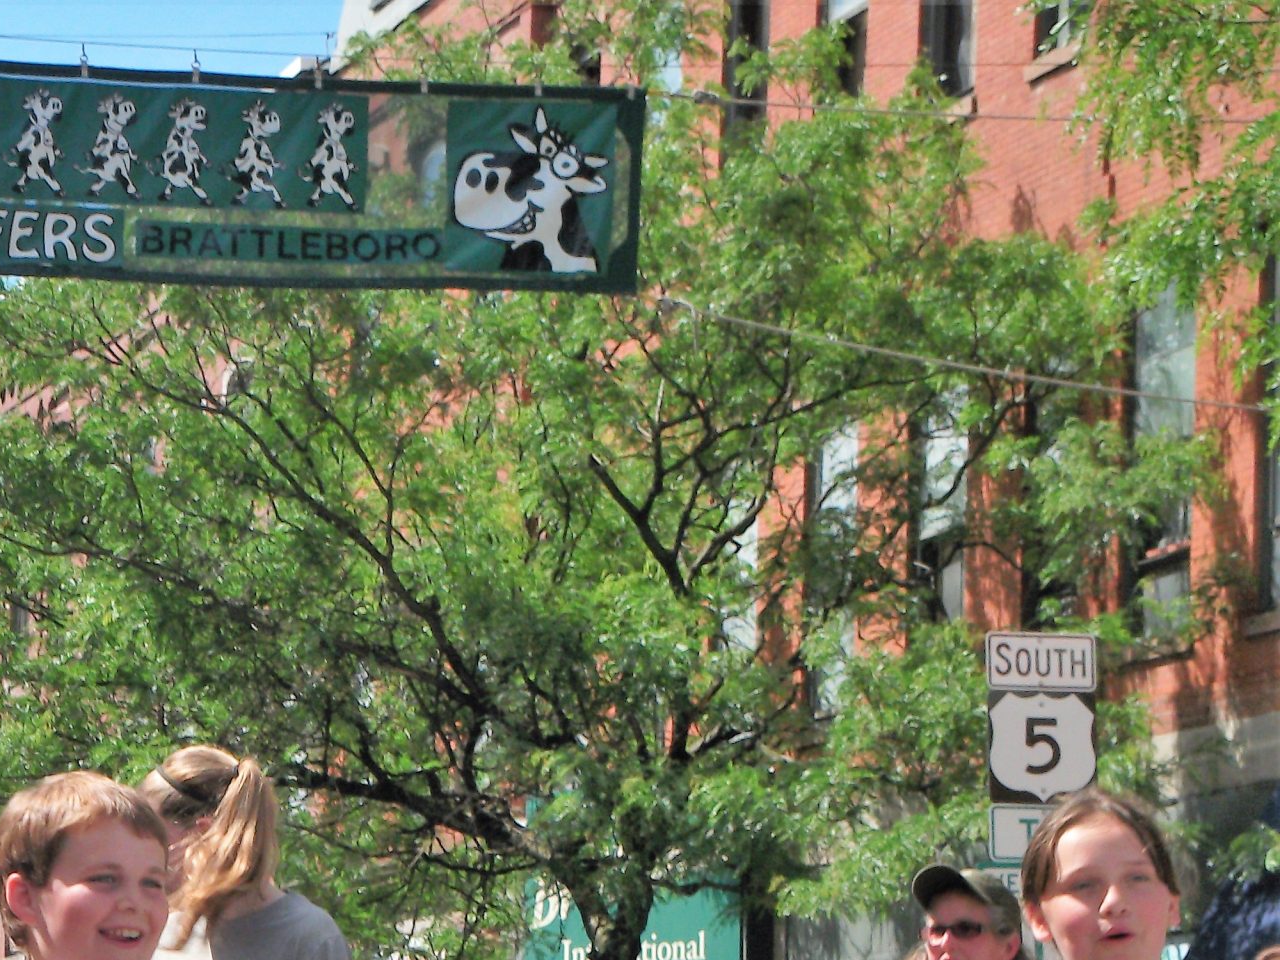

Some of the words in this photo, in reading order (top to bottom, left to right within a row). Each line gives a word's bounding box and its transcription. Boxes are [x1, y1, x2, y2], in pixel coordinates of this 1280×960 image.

[141, 225, 441, 261] BRATTLEBORO
[995, 643, 1086, 678] SOUTH
[1025, 718, 1061, 774] 5
